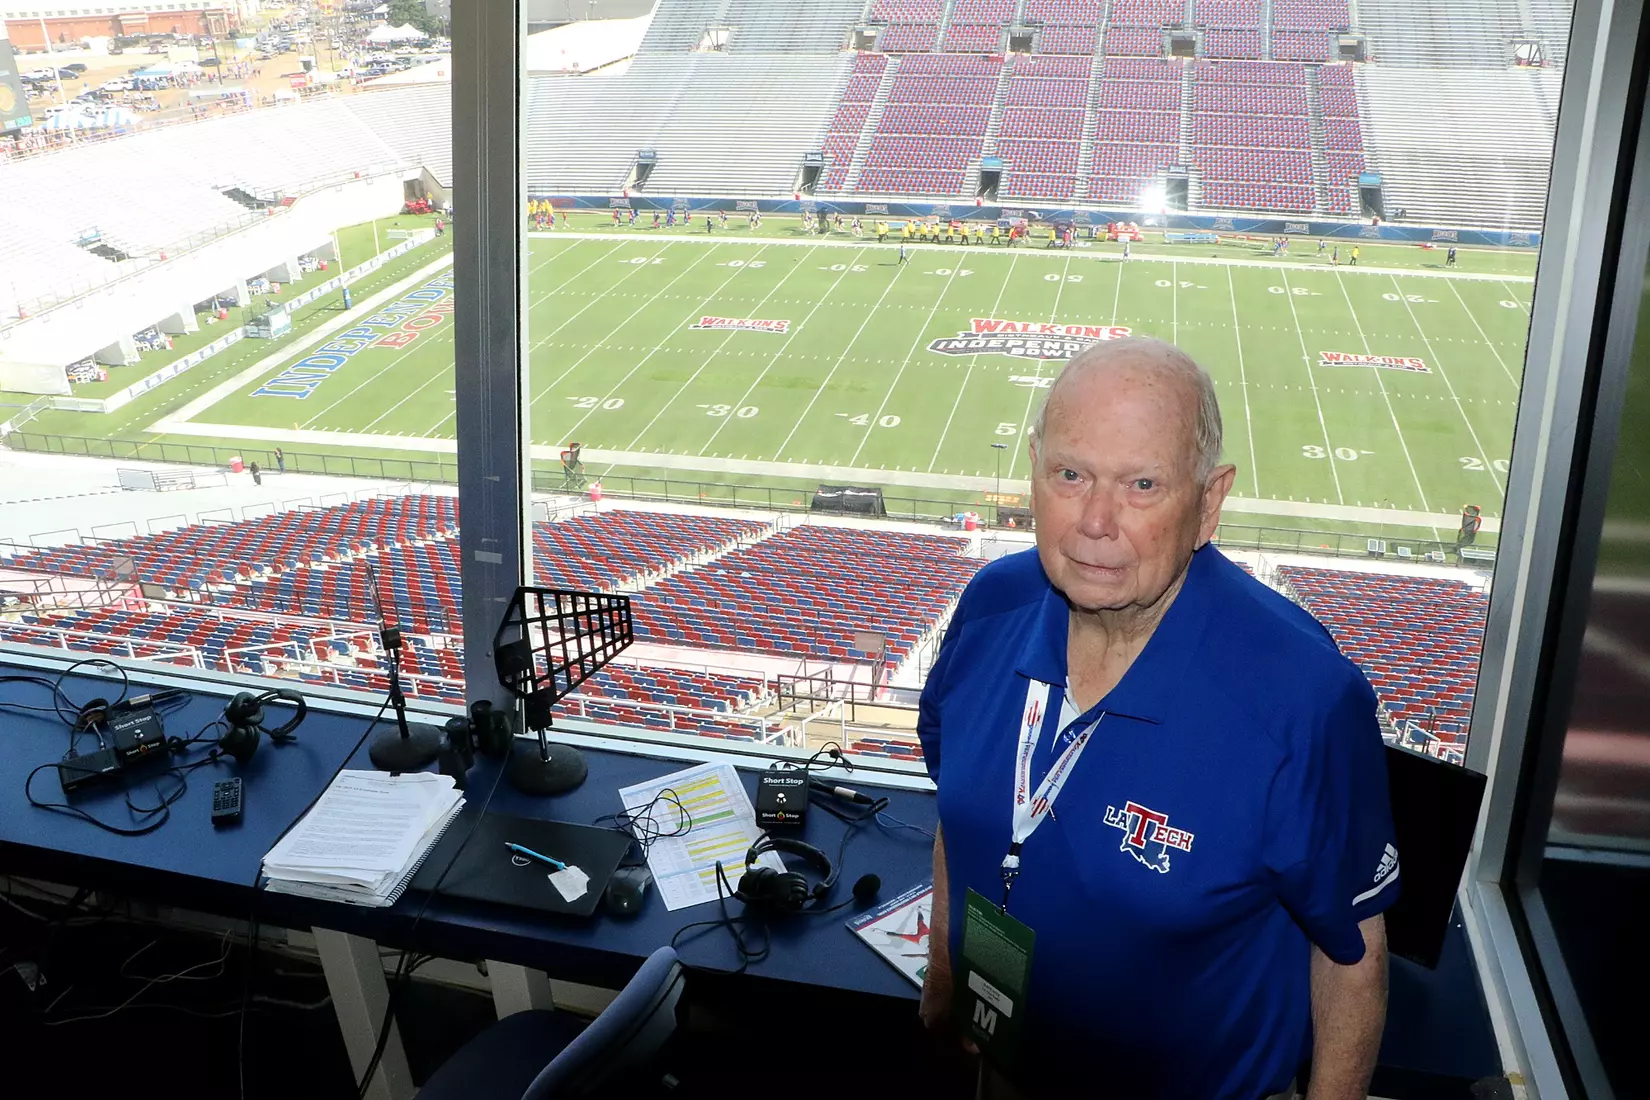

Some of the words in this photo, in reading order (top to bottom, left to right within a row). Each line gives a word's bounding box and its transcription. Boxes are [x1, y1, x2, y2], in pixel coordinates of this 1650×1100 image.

[573, 396, 625, 410] 20
[705, 403, 760, 418] 30
[848, 413, 901, 428] 40
[1301, 444, 1359, 461] 30
[786, 777, 804, 786] Stop
[972, 999, 998, 1037] M
